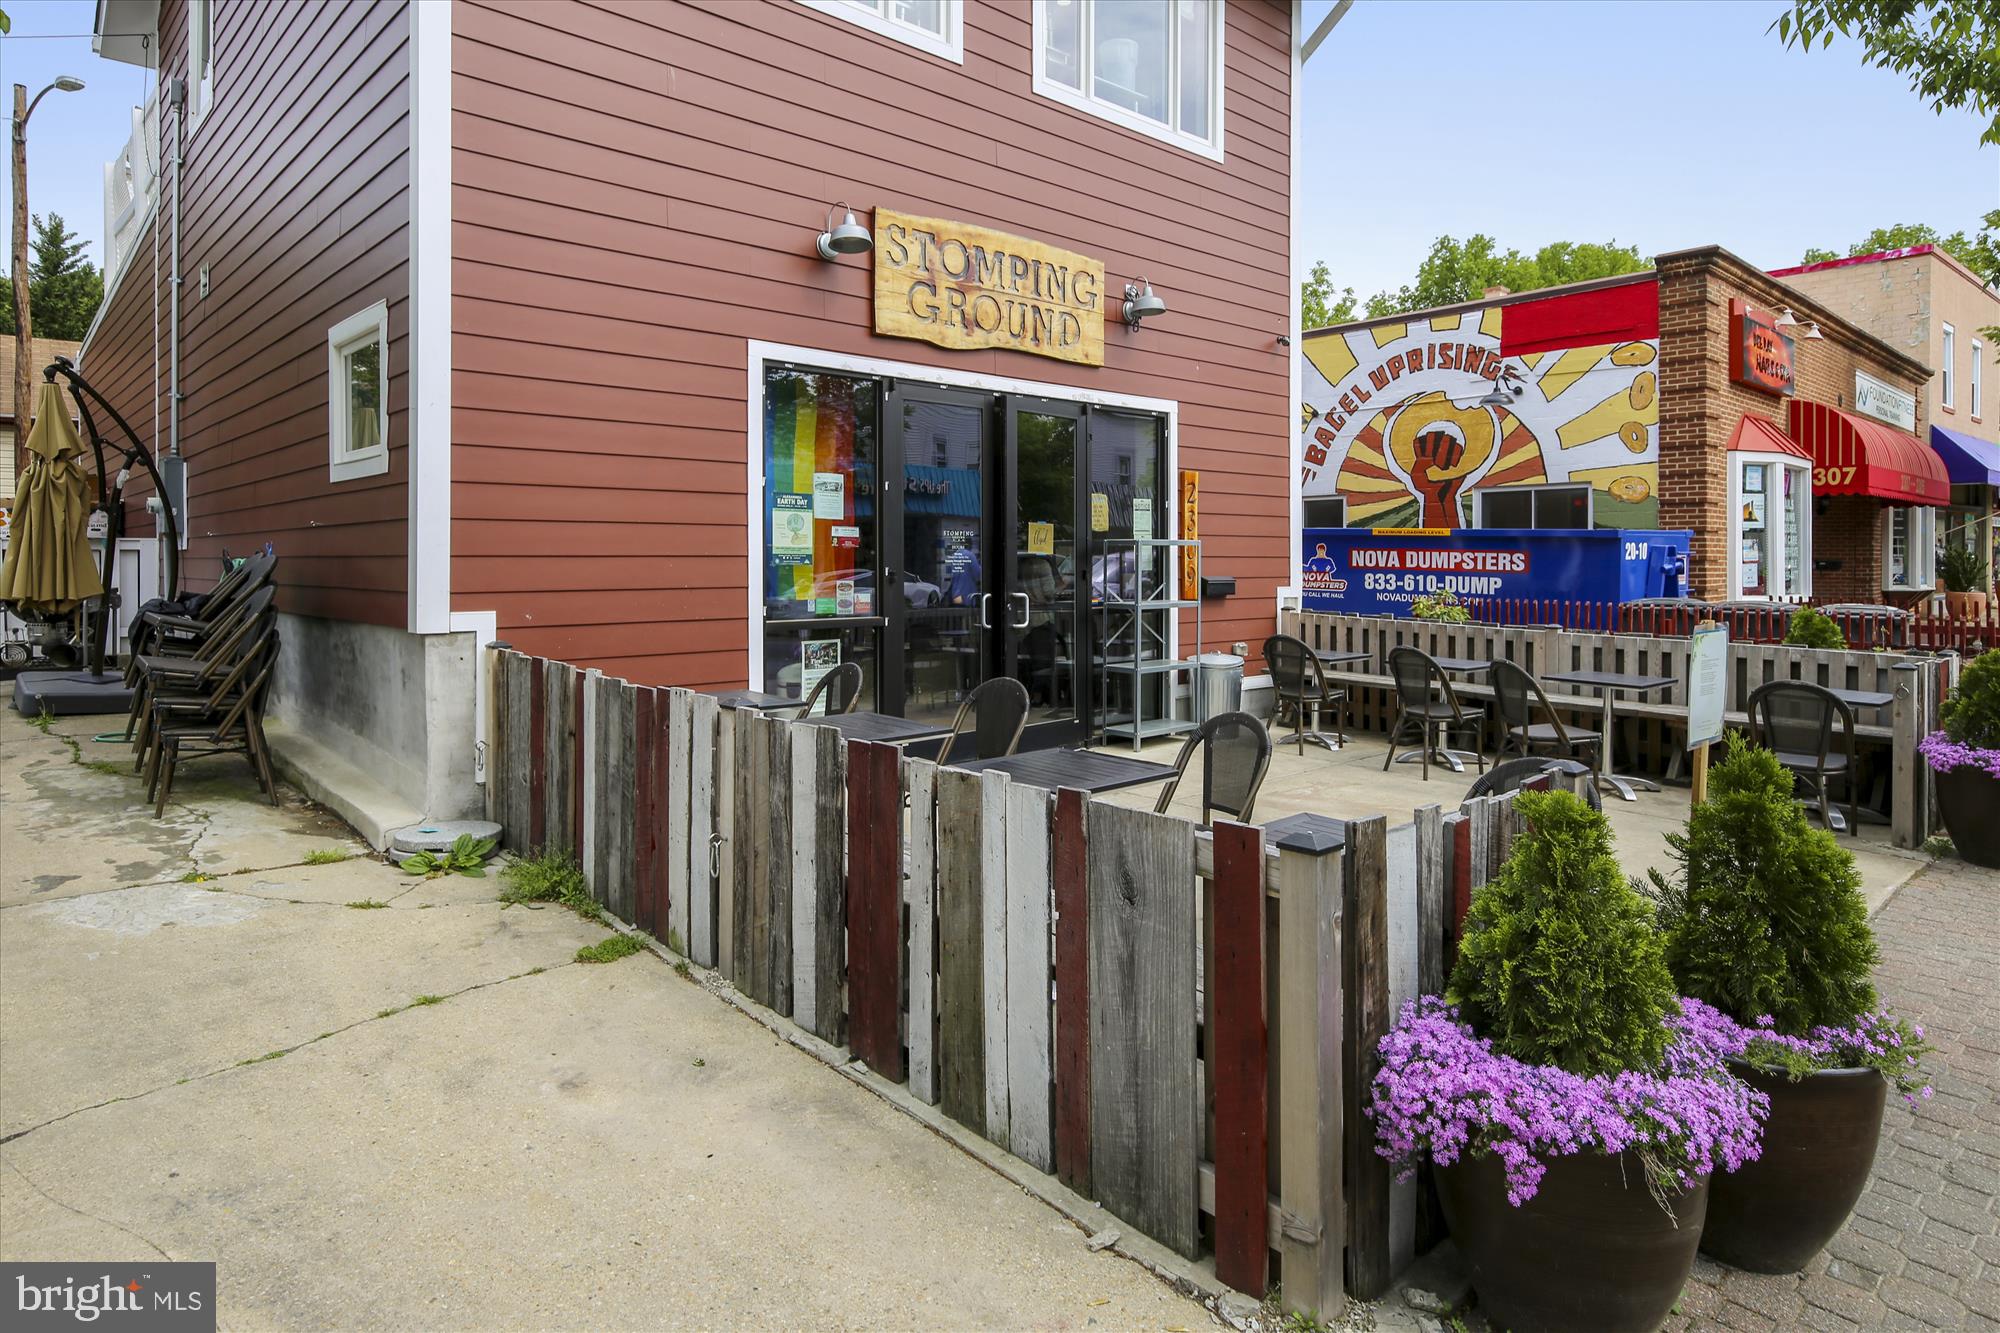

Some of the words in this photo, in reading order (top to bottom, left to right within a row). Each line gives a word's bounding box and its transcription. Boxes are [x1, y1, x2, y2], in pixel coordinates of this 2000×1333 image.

[885, 223, 1098, 309] STOMPING
[907, 280, 1081, 347] GROUND
[1304, 384, 1372, 466] BAGEL
[1368, 343, 1503, 392] UPRISING
[1352, 550, 1400, 568] NOVA
[1406, 551, 1525, 572] DUMPSTERS
[1625, 542, 1648, 560] 20-10
[1302, 572, 1330, 580] NOVA
[1364, 573, 1503, 595] 833-610-DUMP
